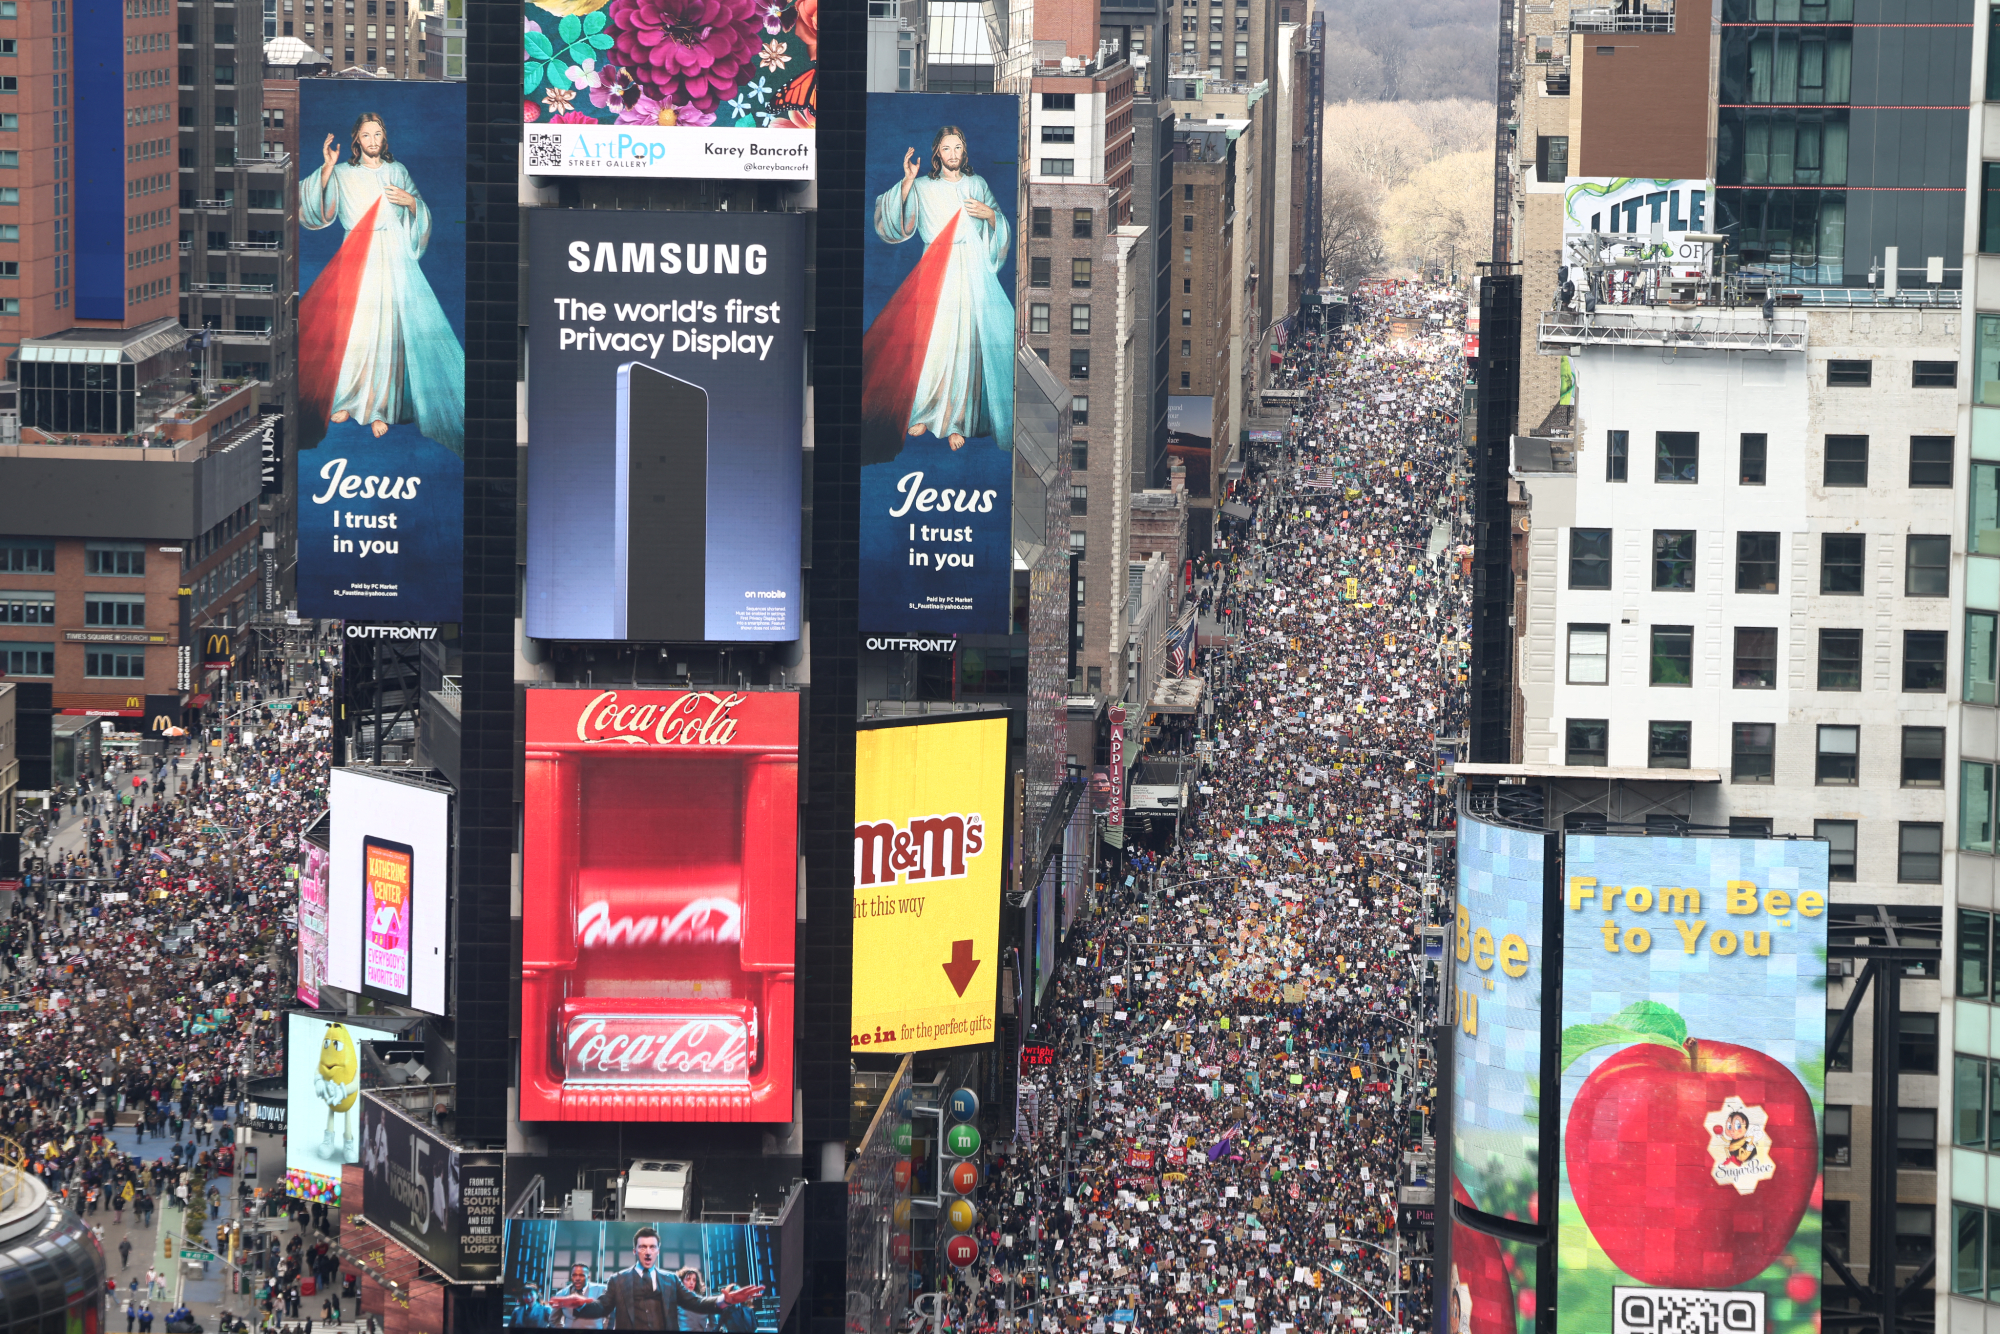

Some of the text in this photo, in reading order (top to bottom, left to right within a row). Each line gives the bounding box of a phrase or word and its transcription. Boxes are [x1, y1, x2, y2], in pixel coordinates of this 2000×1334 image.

[569, 133, 665, 165] ArtPop
[704, 142, 809, 159] Karey Bancroft
[568, 159, 648, 168] STREET GALLERY
[743, 163, 809, 173] @kareybancroft
[567, 240, 767, 275] SAMSUNG
[554, 298, 780, 324] The world's first
[559, 327, 774, 361] Privacy Display
[312, 457, 421, 504] Jesus
[889, 471, 997, 518] Jesus
[333, 510, 398, 530] I trust
[909, 523, 973, 542] I trust
[333, 534, 399, 558] in you
[908, 547, 974, 571] in you
[757, 590, 786, 599] mobile
[577, 691, 749, 745] Coca-Cola
[369, 858, 407, 884] KATHERINE
[375, 880, 401, 904] CENTER
[1570, 876, 1825, 917] From Bee
[870, 895, 896, 916] this
[898, 896, 926, 918] way
[1457, 903, 1529, 978] Bee
[1600, 920, 1651, 953] to
[1673, 920, 1771, 957] You
[368, 948, 405, 972] EVERYBODY'S
[368, 966, 405, 990] FAVORITE GUY
[874, 1025, 896, 1043] in
[900, 1023, 915, 1041] for
[916, 1021, 933, 1039] the
[934, 1017, 968, 1041] perfect
[969, 1014, 992, 1036] gifts
[582, 1060, 735, 1072] ICE COLD
[464, 1187, 500, 1196] CREATORS OF
[469, 1178, 495, 1187] FROM THE
[463, 1197, 500, 1206] SOUTH
[467, 1206, 496, 1215] PARK
[468, 1216, 494, 1225] AND EGOT
[470, 1226, 491, 1235] WINNER
[460, 1236, 502, 1244] ROBERT
[464, 1245, 498, 1254] LOPEZ
